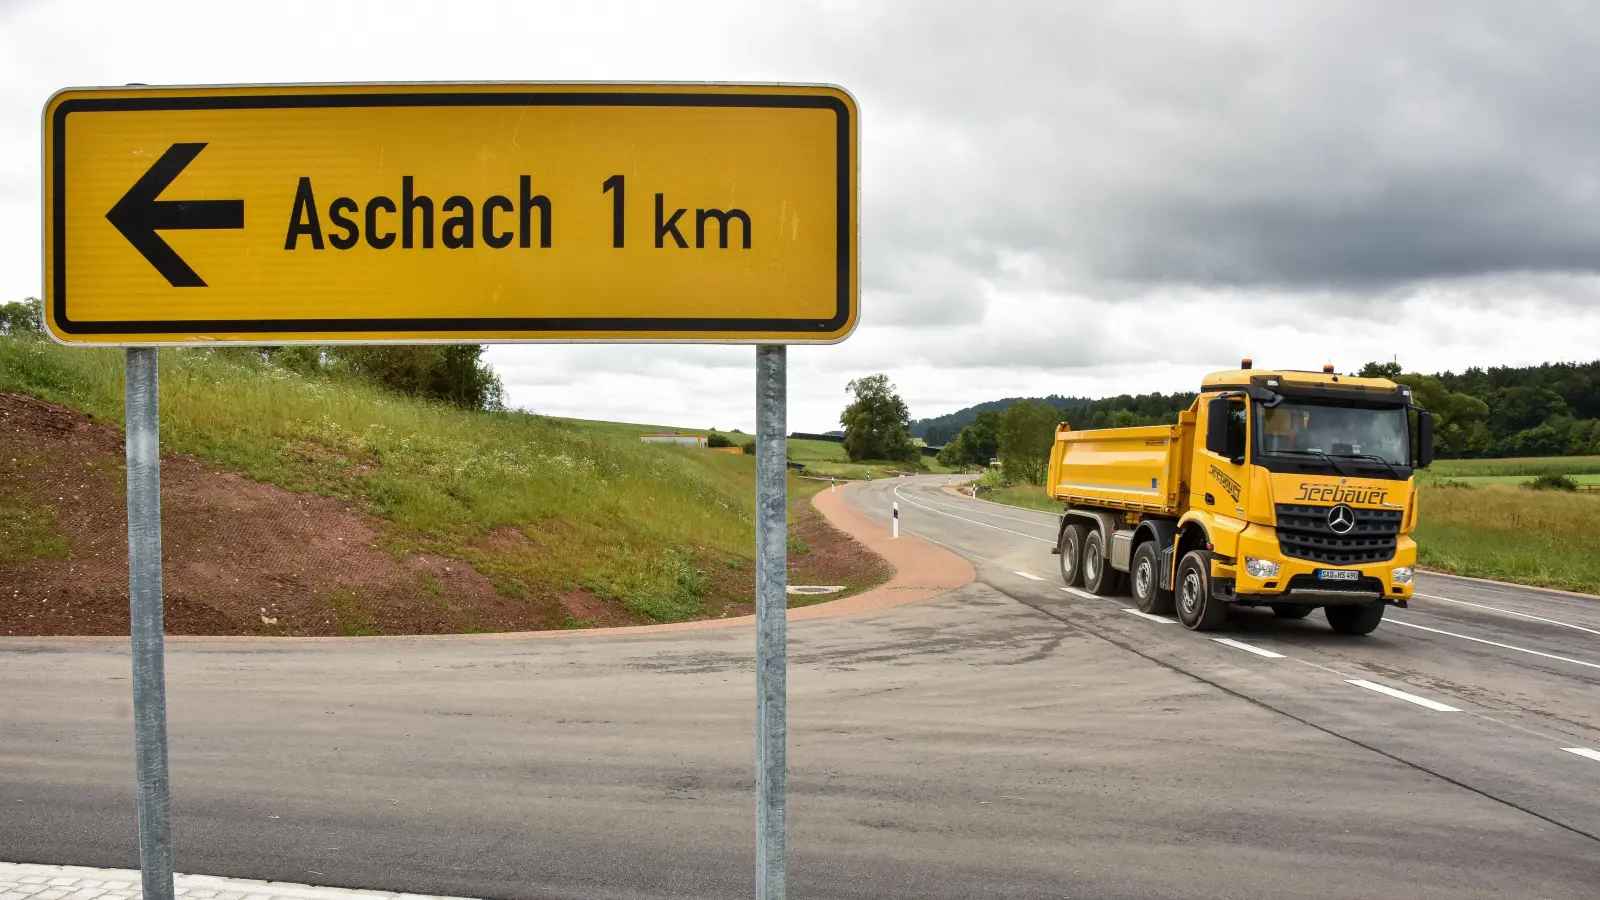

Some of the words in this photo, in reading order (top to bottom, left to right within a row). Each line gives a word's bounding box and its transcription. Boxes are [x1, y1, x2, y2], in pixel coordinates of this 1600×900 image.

[284, 175, 552, 250] Aschach
[602, 174, 625, 249] 1
[654, 193, 752, 249] km
[1208, 464, 1241, 500] Seebauer
[1295, 483, 1388, 505] Seebauer
